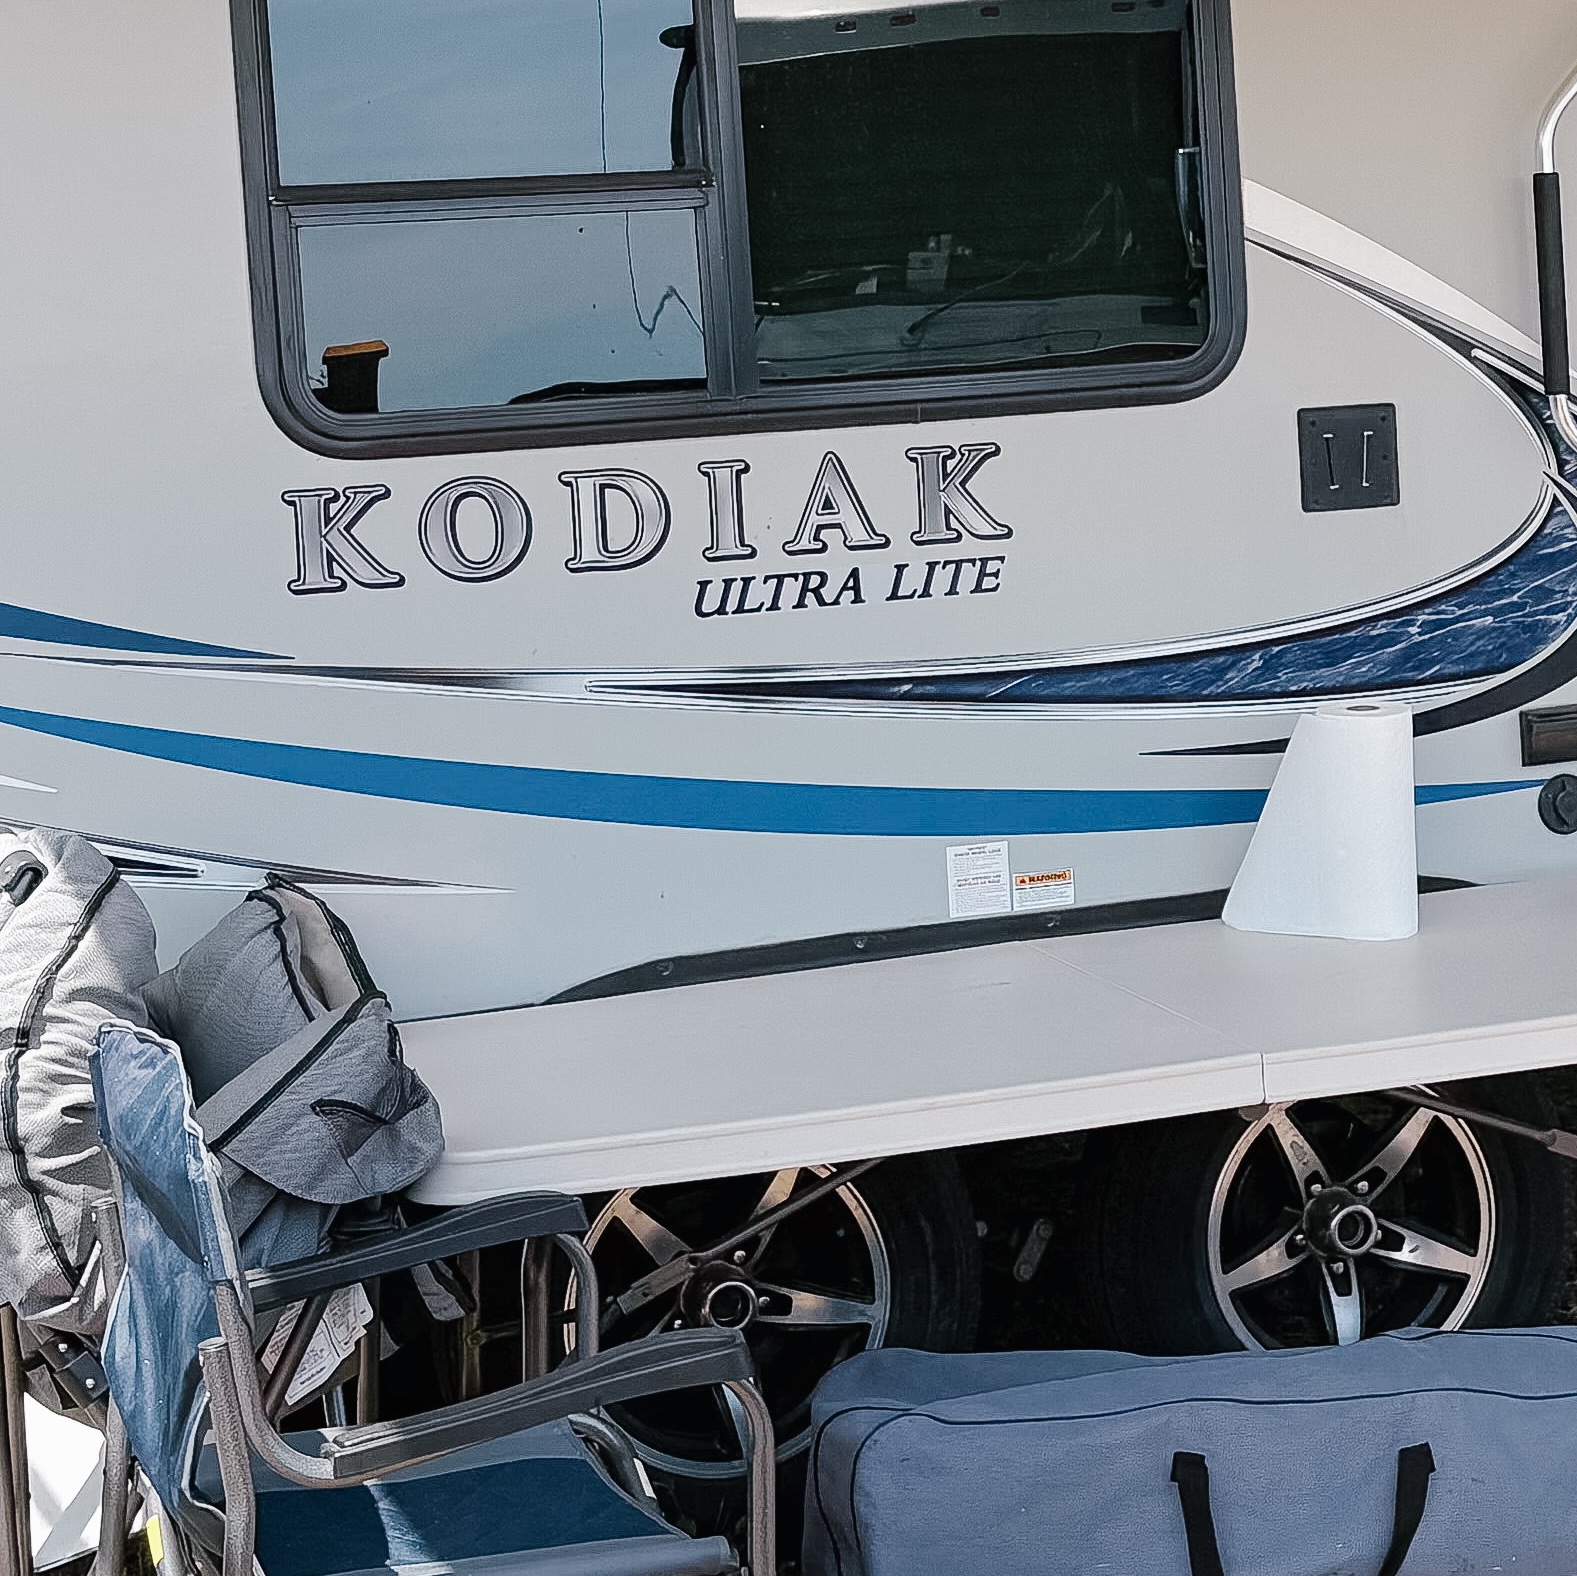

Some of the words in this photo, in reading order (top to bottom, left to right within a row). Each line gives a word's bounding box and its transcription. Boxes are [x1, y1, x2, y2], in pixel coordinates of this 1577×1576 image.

[282, 443, 1014, 596] KODIAK
[693, 568, 865, 619] ULTRA
[885, 556, 1006, 602] LITE
